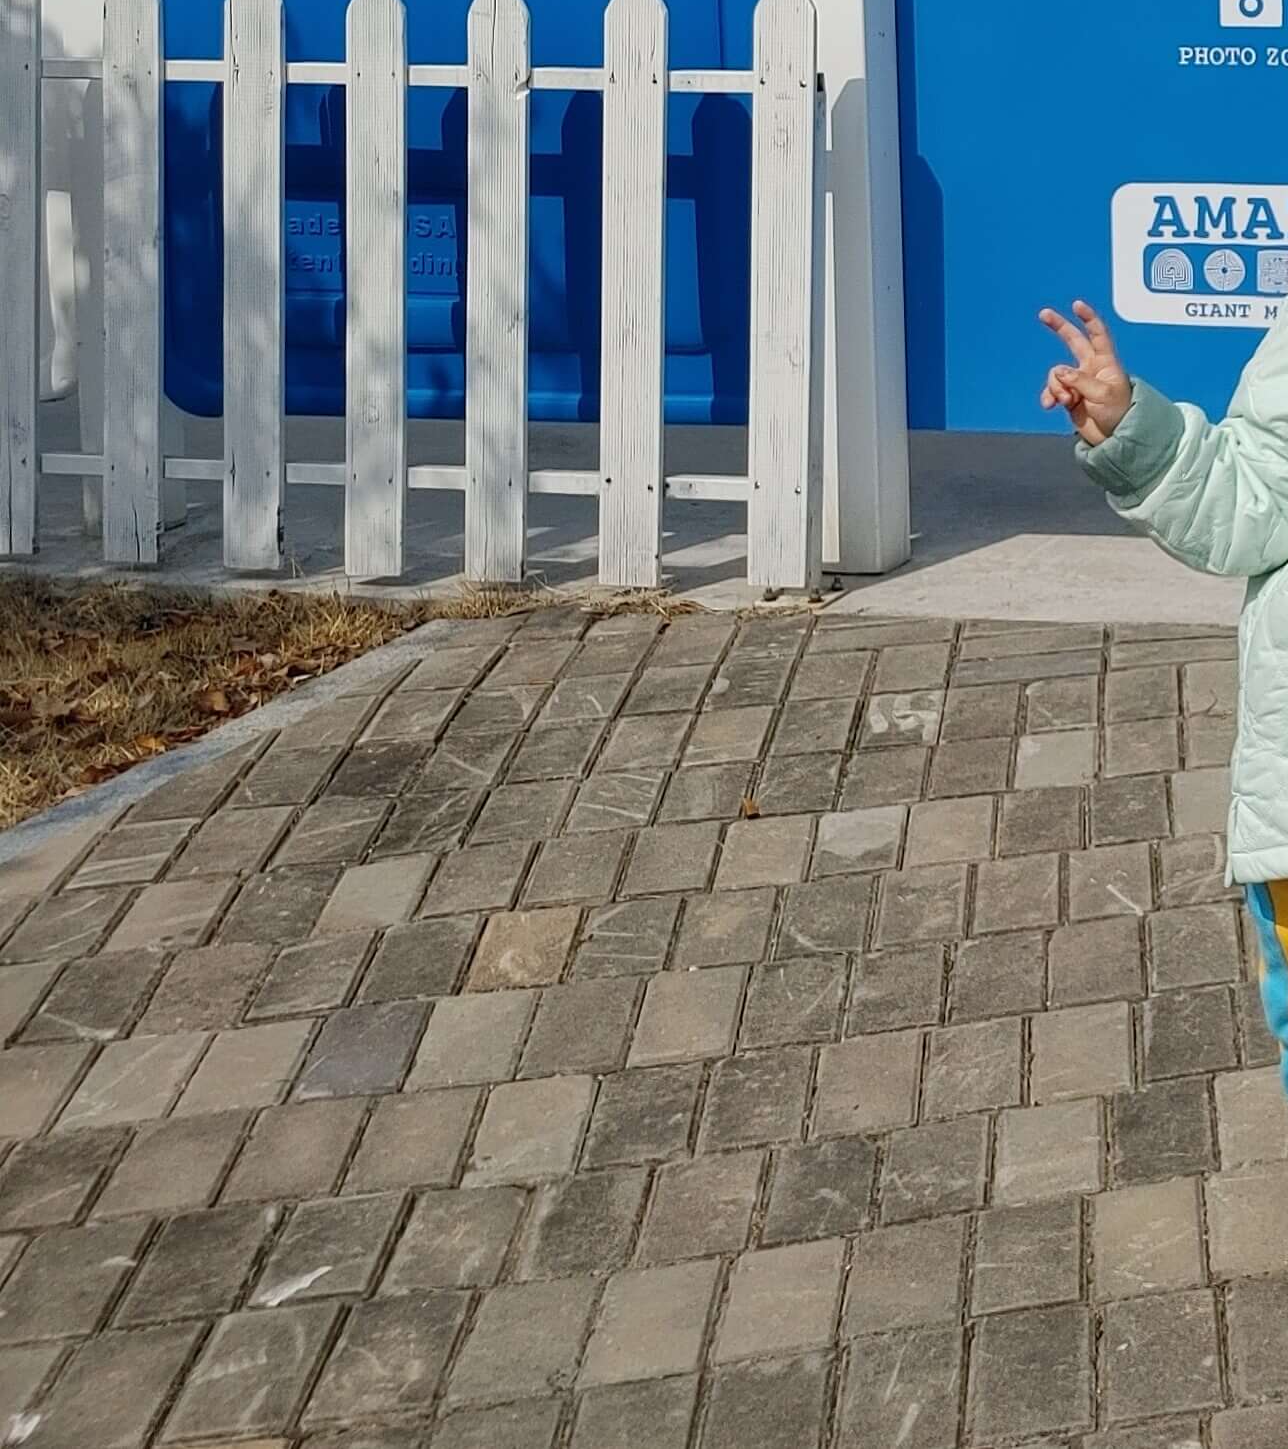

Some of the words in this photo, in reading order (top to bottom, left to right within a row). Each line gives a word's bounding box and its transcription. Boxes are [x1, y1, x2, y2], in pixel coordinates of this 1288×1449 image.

[1178, 47, 1257, 66] PHOTO
[287, 213, 342, 237] ade
[1185, 302, 1250, 318] GIANT
